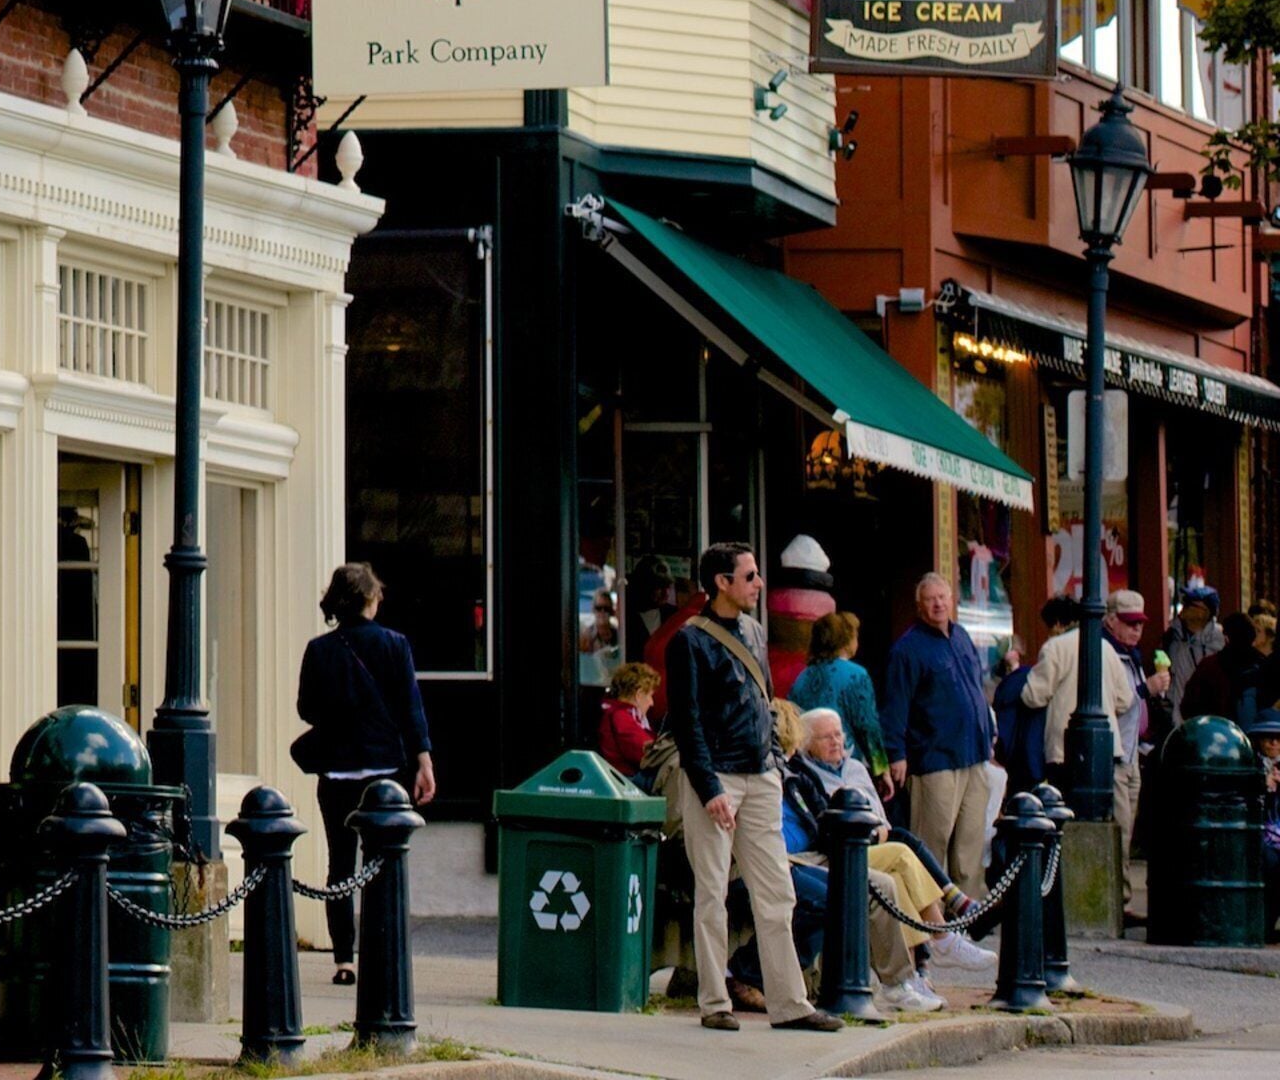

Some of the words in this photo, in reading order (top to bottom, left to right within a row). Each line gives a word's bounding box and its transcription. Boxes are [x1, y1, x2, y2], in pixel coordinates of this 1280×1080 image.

[863, 2, 902, 22] ICE
[915, 1, 1003, 23] CREAM
[367, 40, 419, 65] Park
[431, 38, 548, 66] Company
[848, 32, 899, 53] MADE
[907, 34, 961, 57] FRESH
[969, 35, 1018, 58] DAILY
